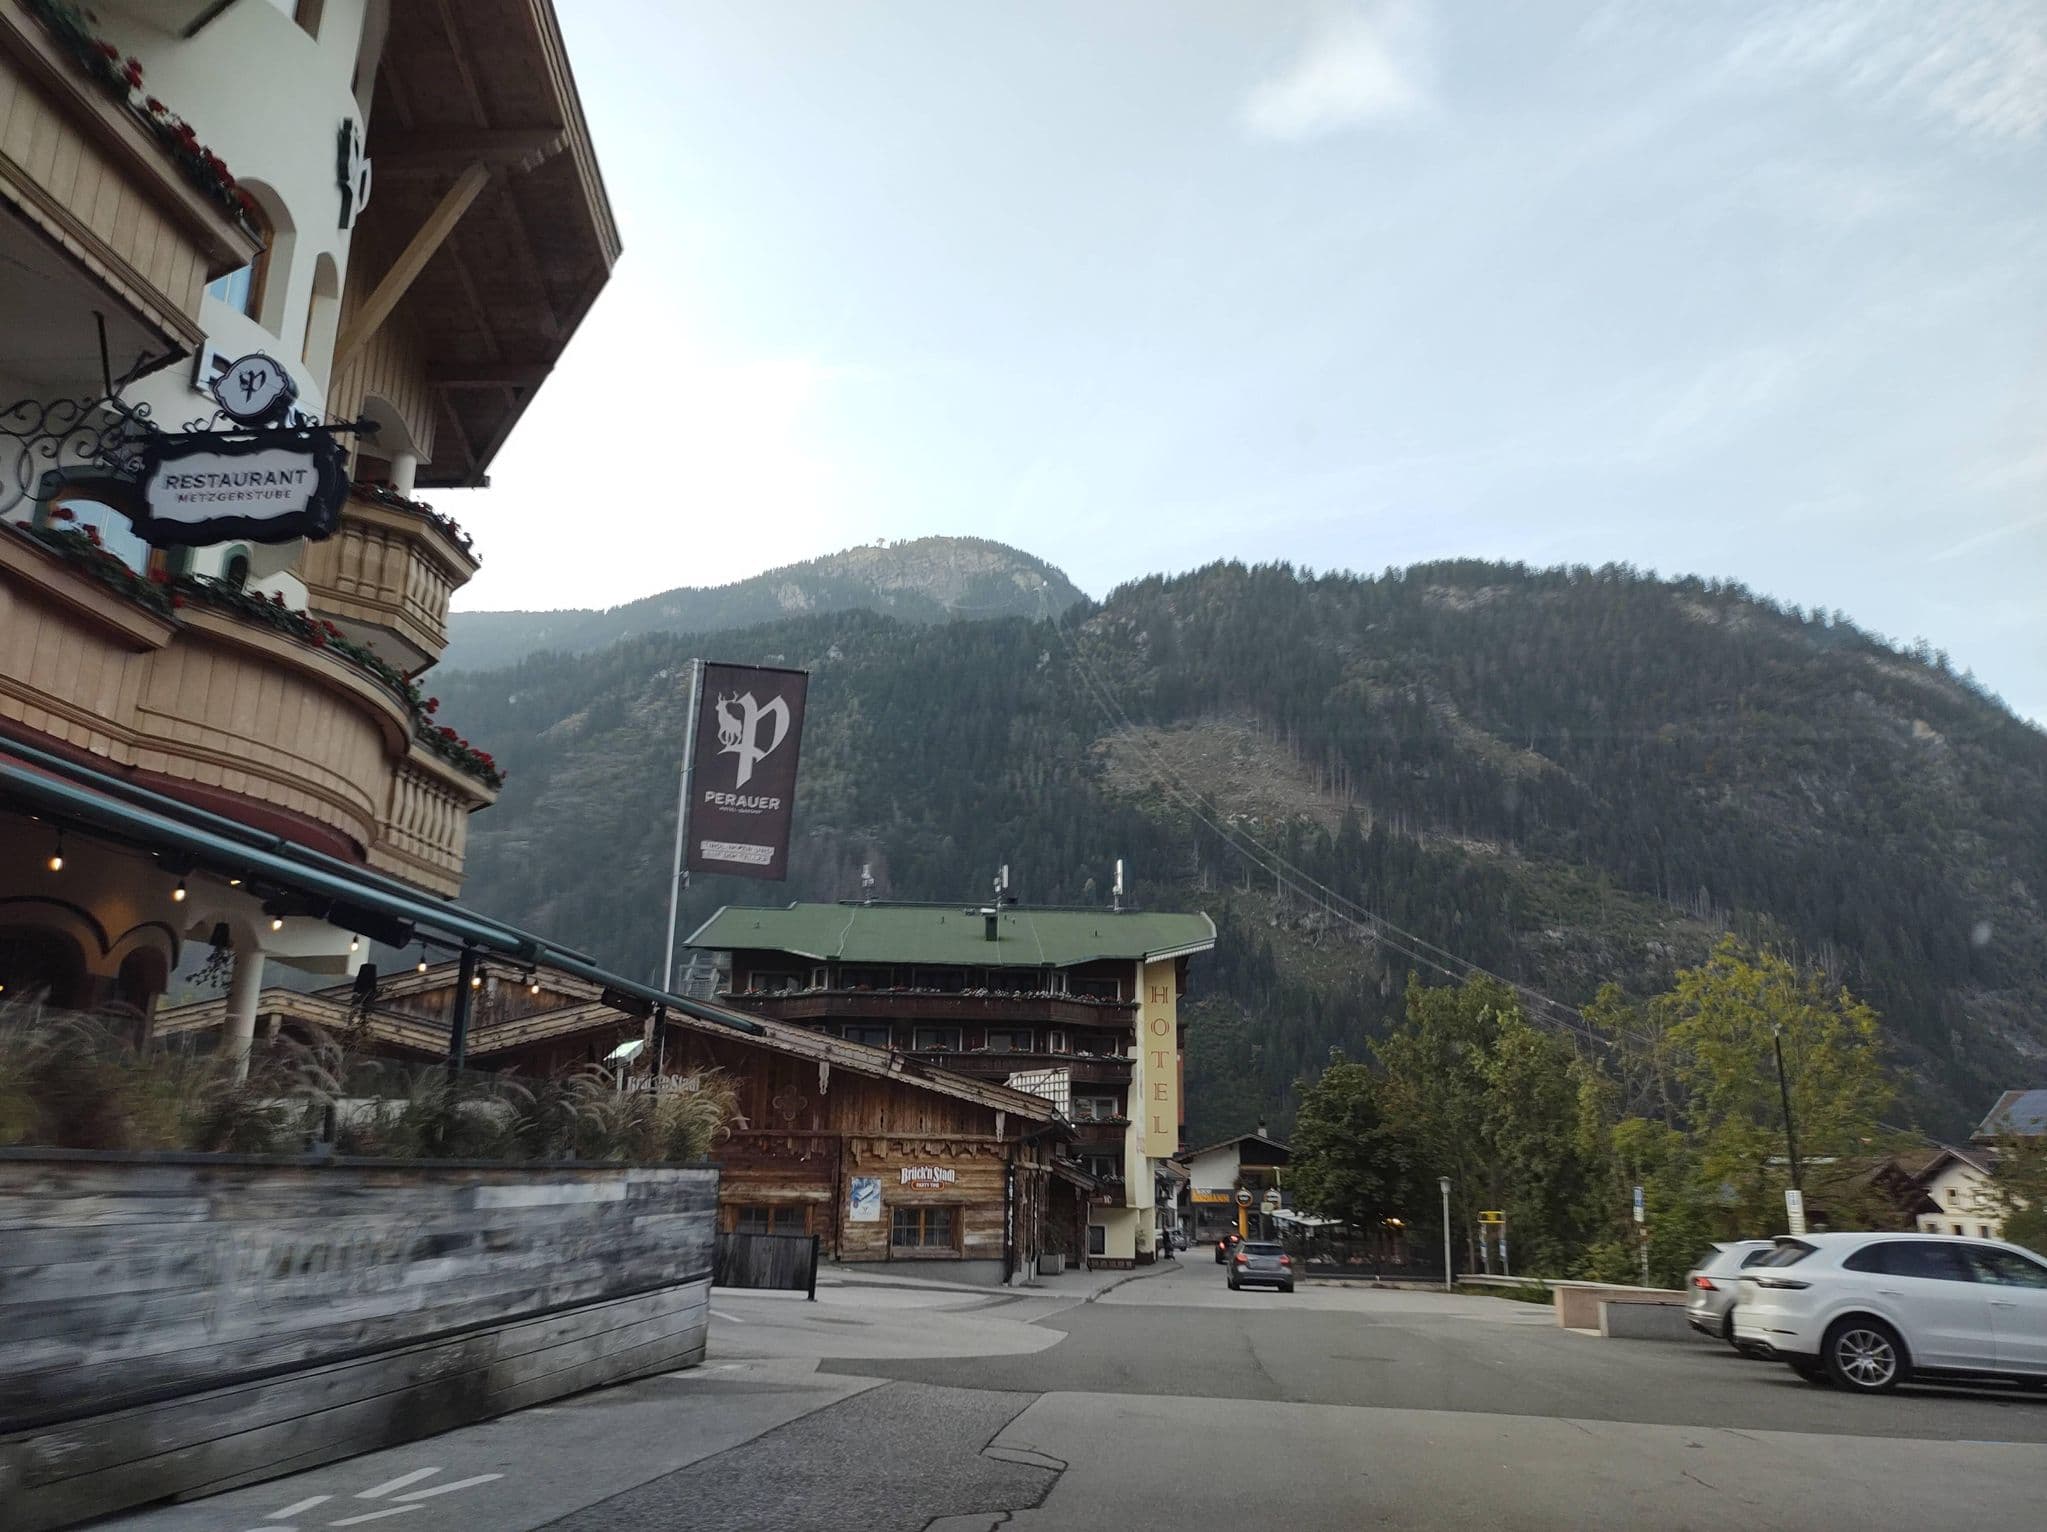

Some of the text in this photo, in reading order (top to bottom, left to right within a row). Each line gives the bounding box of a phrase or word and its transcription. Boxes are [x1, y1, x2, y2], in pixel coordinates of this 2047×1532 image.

[164, 469, 308, 491] RESTAURANT
[177, 489, 293, 504] METZGERSTUBE
[704, 791, 781, 810] PERAUER
[1150, 985, 1170, 1135] HOTEL
